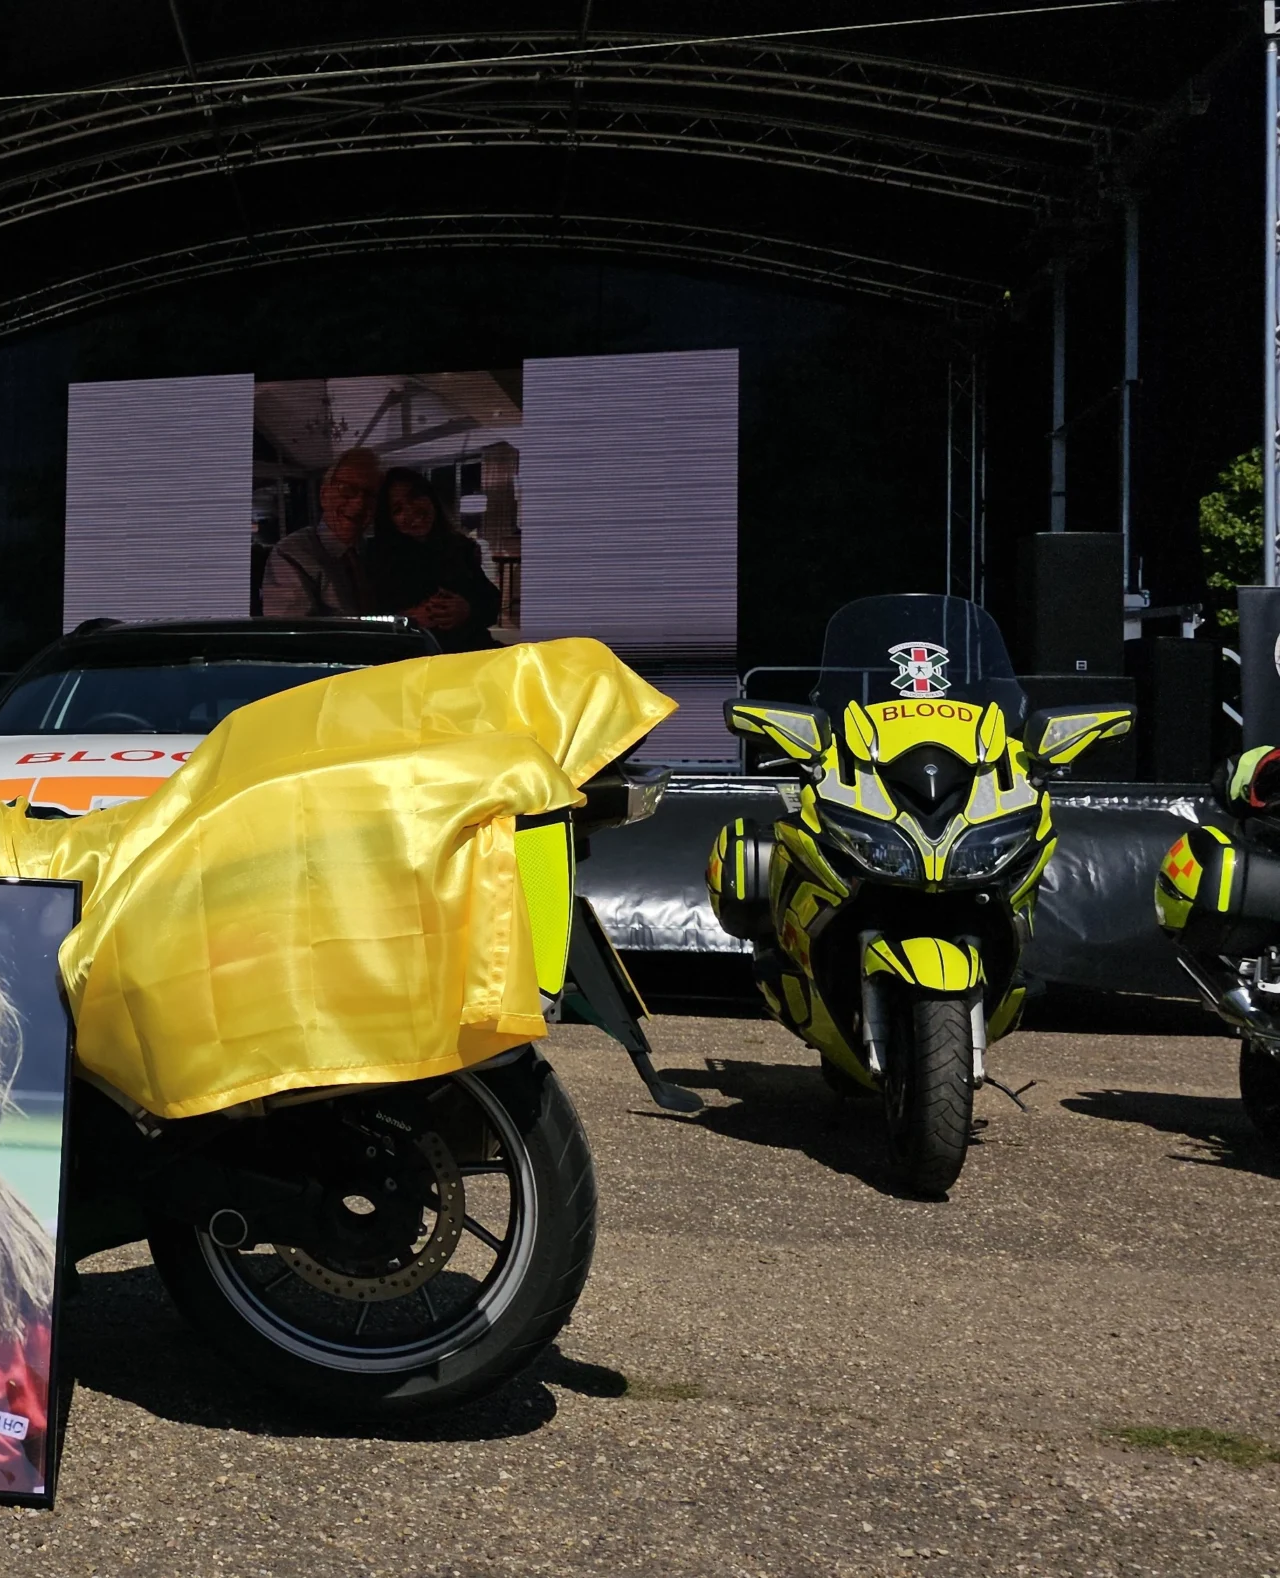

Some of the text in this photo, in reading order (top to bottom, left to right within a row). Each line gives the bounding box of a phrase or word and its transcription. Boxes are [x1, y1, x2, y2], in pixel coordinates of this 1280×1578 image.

[882, 703, 973, 722] BLOOD
[376, 1110, 412, 1132] brembo
[3, 1418, 24, 1434] HC
